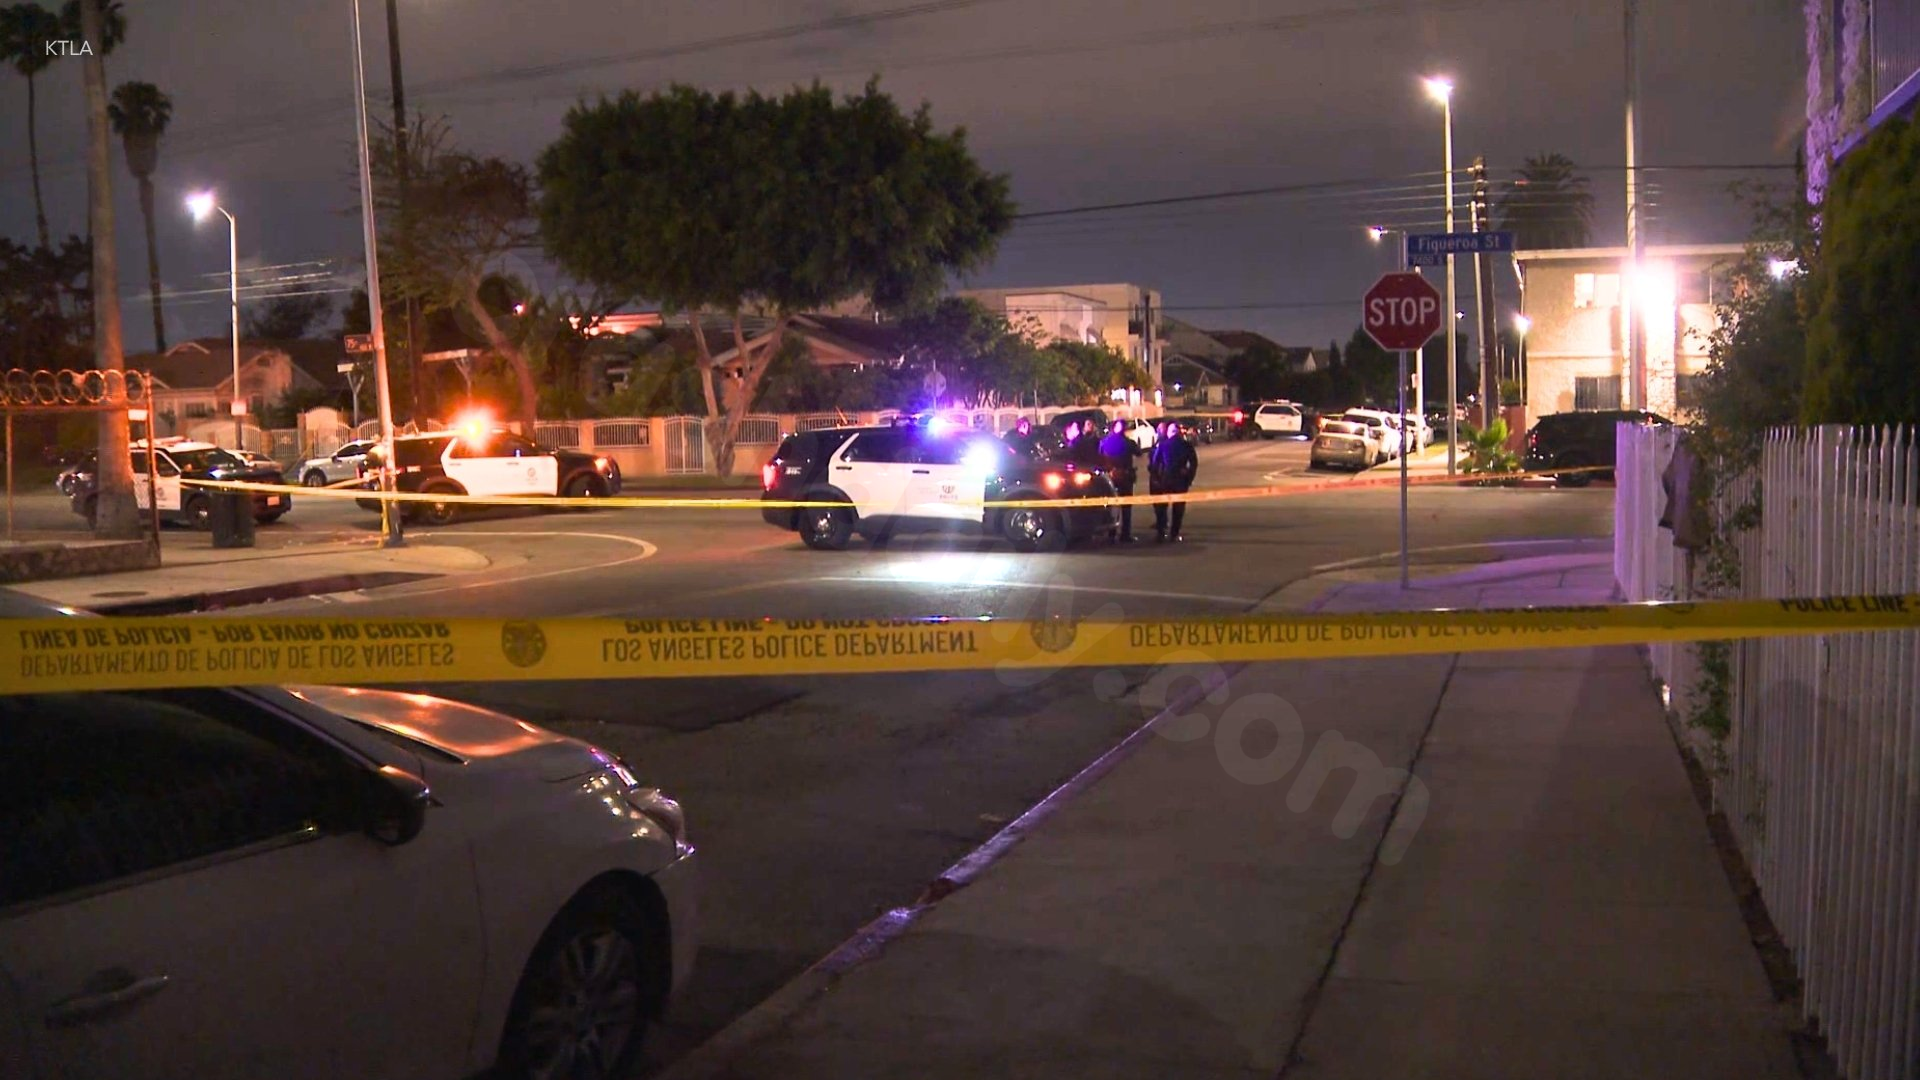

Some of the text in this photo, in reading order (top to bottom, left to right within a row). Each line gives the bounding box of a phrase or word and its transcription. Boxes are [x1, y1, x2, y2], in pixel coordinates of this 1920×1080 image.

[1418, 233, 1500, 254] Figueroa St
[1368, 296, 1436, 327] STOP
[1861, 594, 1909, 612] LINE
